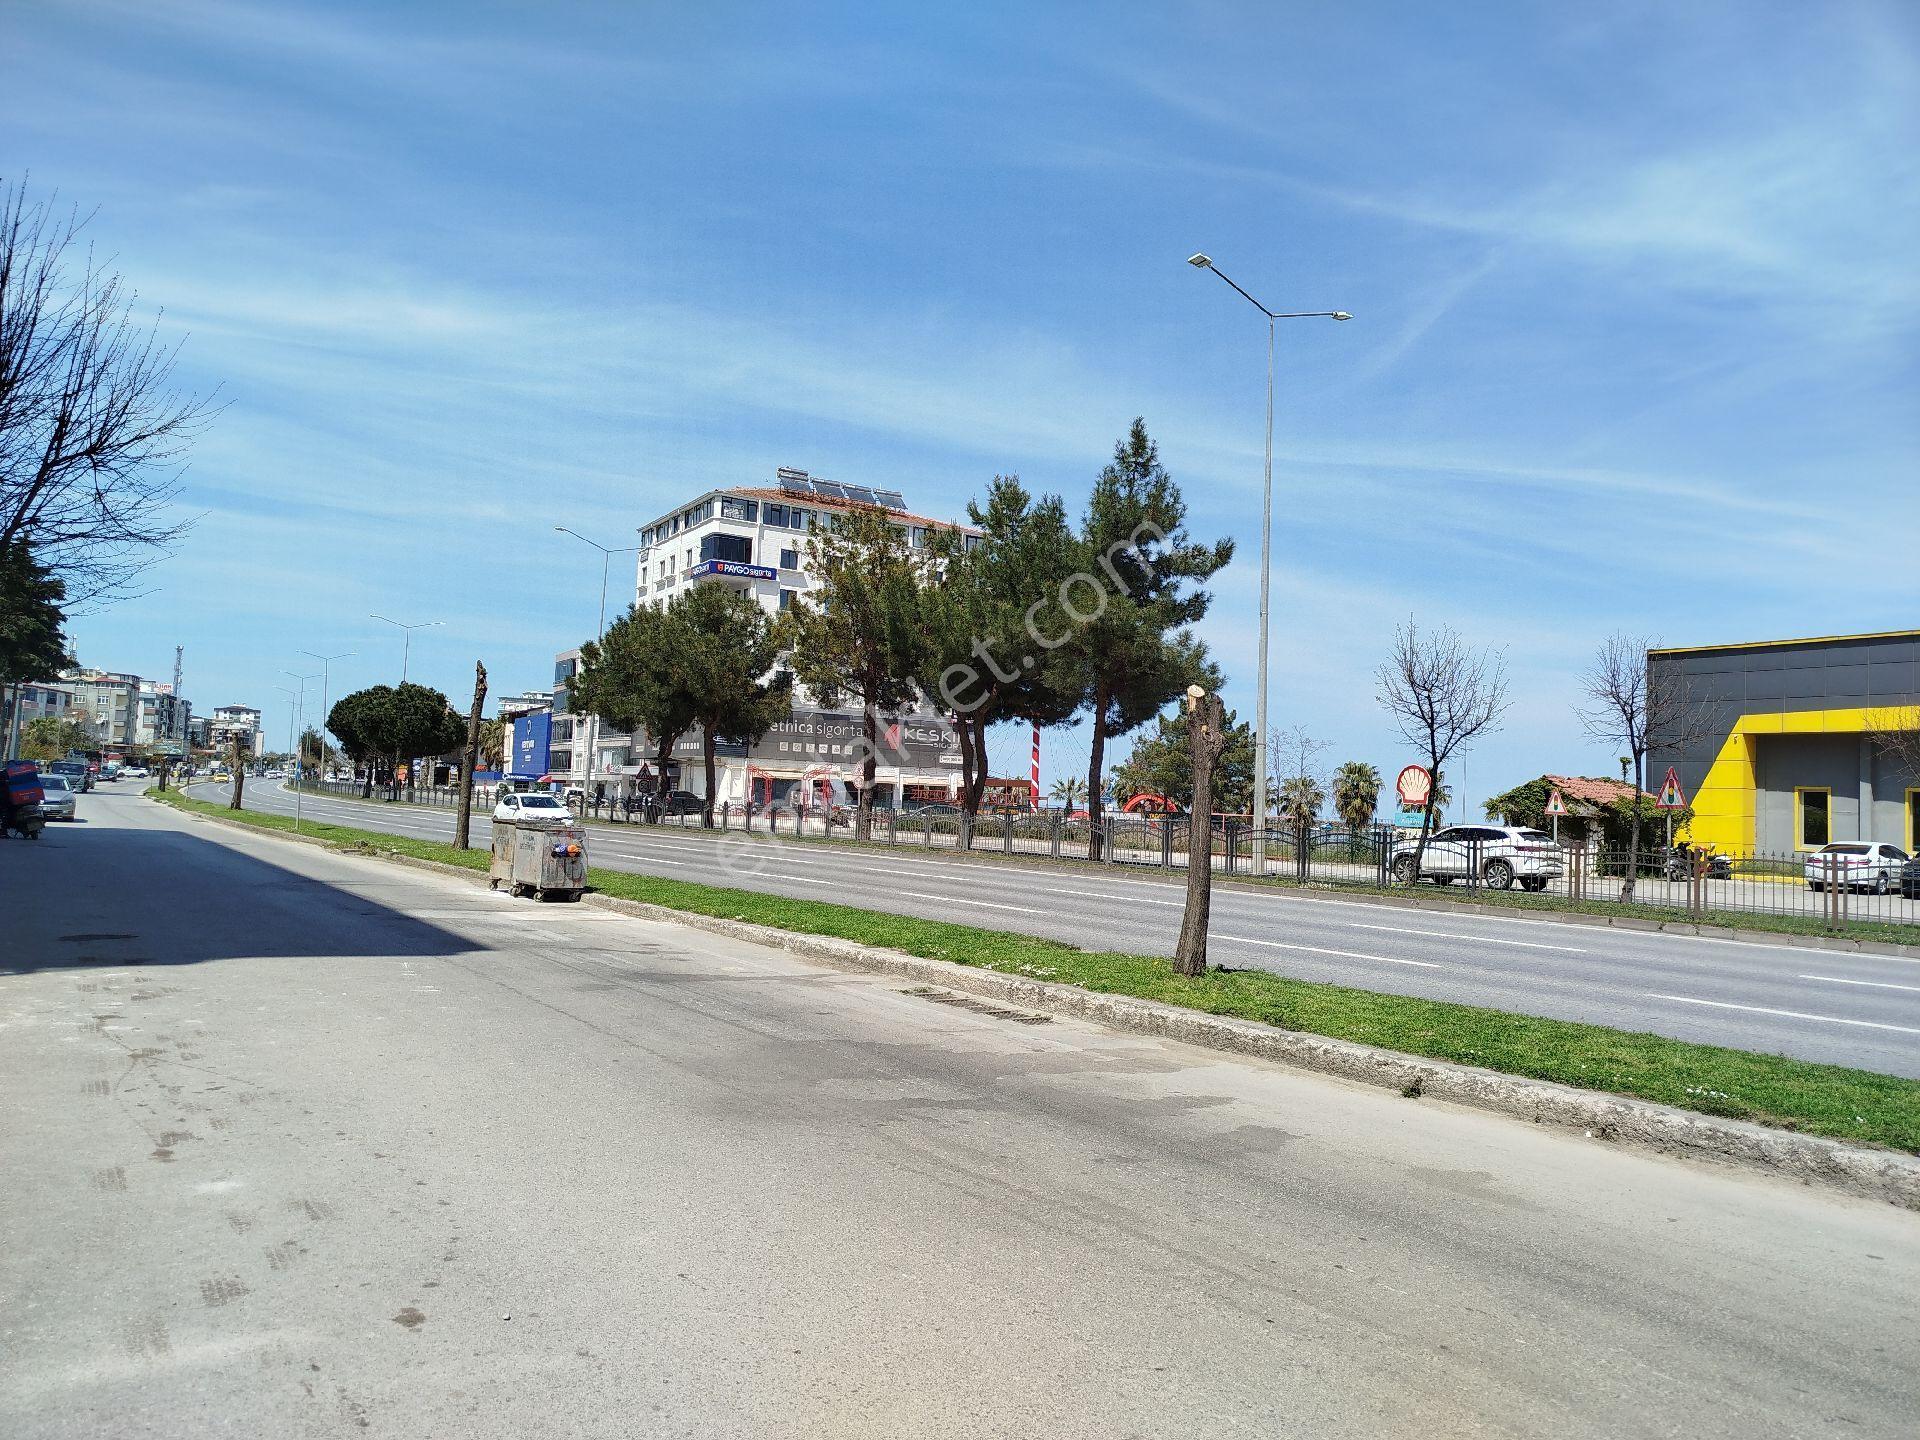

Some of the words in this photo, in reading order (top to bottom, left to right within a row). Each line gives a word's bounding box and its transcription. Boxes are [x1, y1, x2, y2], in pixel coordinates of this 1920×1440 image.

[723, 562, 749, 575] PAYGO
[749, 568, 772, 577] sigorta
[770, 719, 813, 734] ethica
[816, 723, 864, 739] sigorta
